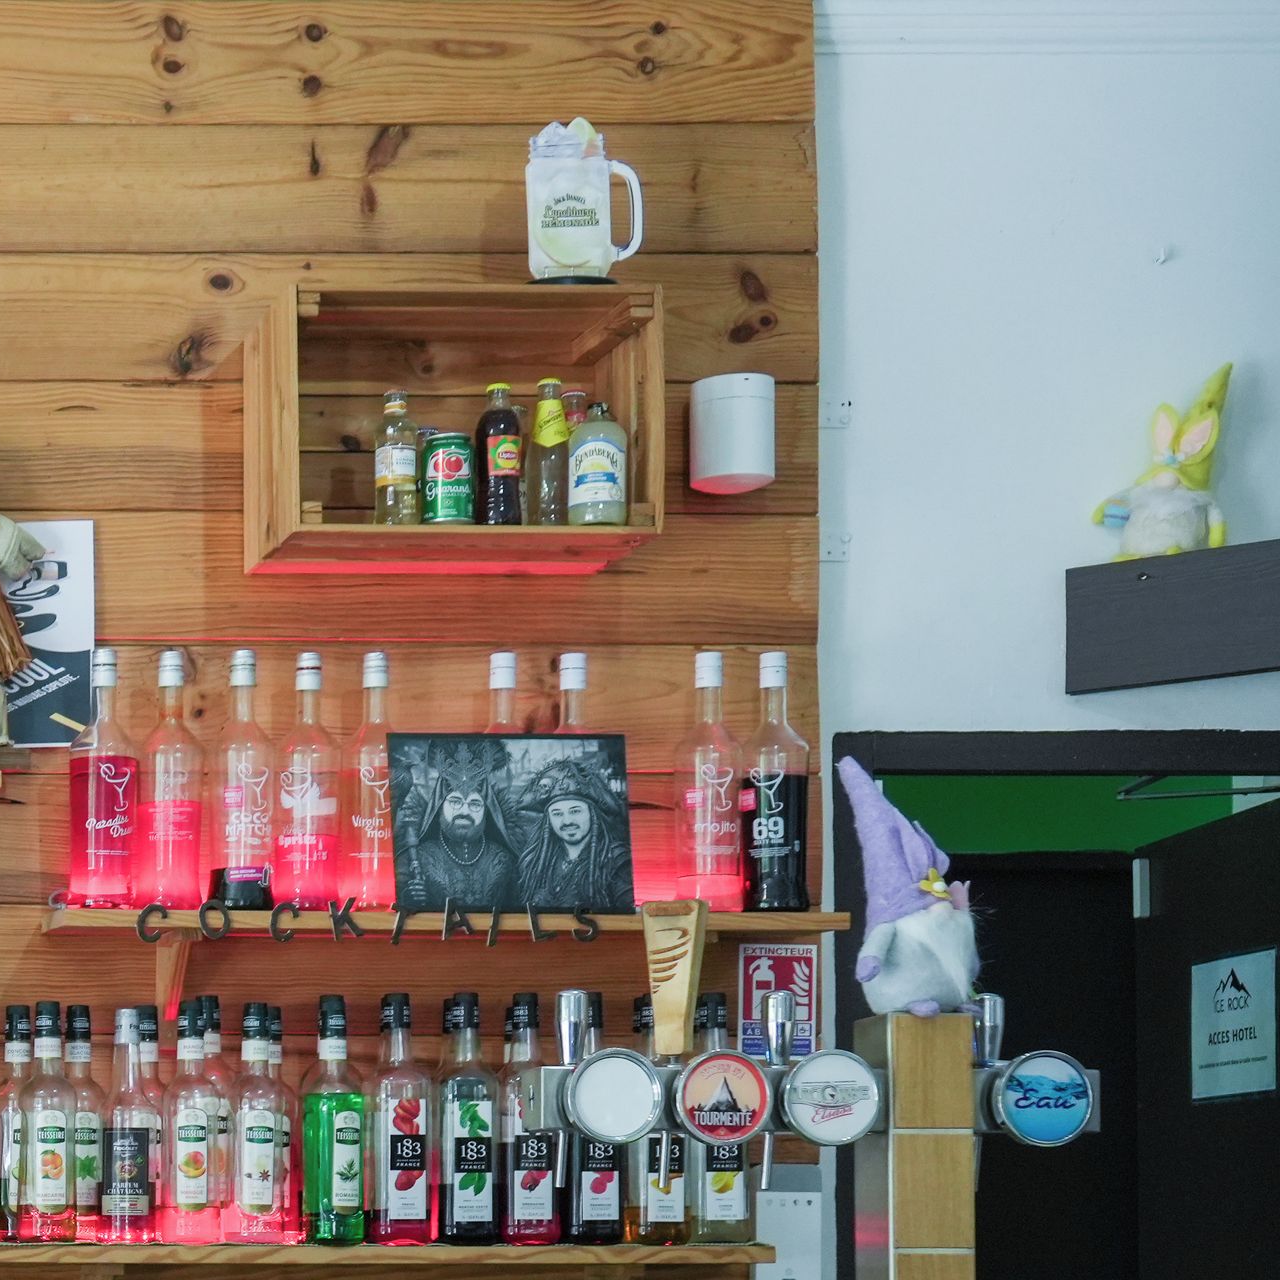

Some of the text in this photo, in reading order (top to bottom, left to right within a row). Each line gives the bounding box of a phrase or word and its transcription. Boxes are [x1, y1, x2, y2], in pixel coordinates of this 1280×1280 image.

[230, 812, 270, 824] COCO
[352, 814, 384, 828] Virgin
[694, 820, 737, 836] mojito
[752, 816, 785, 841] 69
[135, 892, 602, 947] COCKTAILS
[743, 946, 814, 956] EXTINCTEUR
[1227, 995, 1250, 1011] ROCK
[1208, 1026, 1258, 1046] ACCES HOTEL
[1014, 1087, 1078, 1111] Eau
[694, 1111, 753, 1127] TOURMENTE
[38, 1131, 65, 1140] TEISSEIRE
[178, 1129, 207, 1138] TEISSEIRE
[246, 1130, 274, 1139] TEISSEIRE
[397, 1138, 422, 1158] 1883
[460, 1140, 487, 1161] 1883
[521, 1138, 547, 1159] 1883
